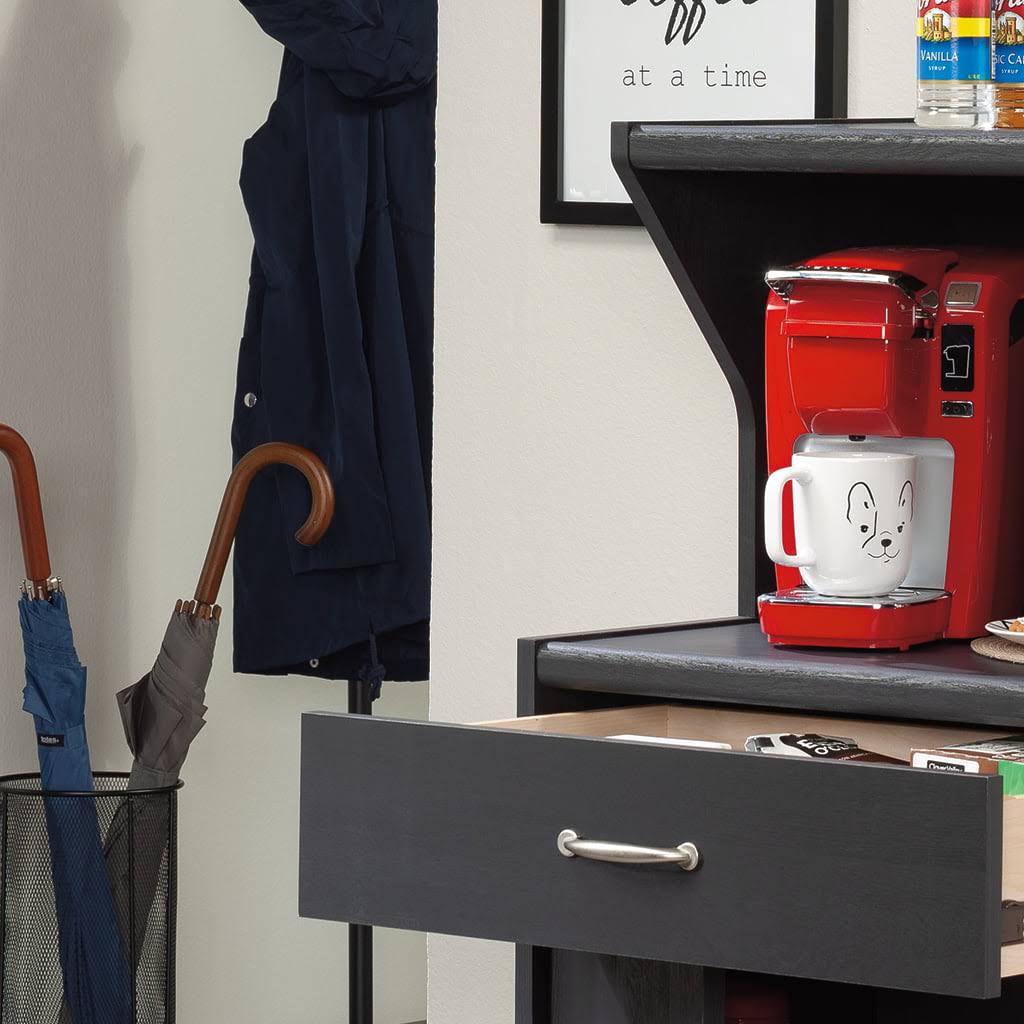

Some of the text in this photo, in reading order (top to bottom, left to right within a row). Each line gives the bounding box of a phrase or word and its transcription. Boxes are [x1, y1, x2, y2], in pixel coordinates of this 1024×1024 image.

[920, 49, 958, 62] VANILLA
[622, 63, 768, 88] at a time
